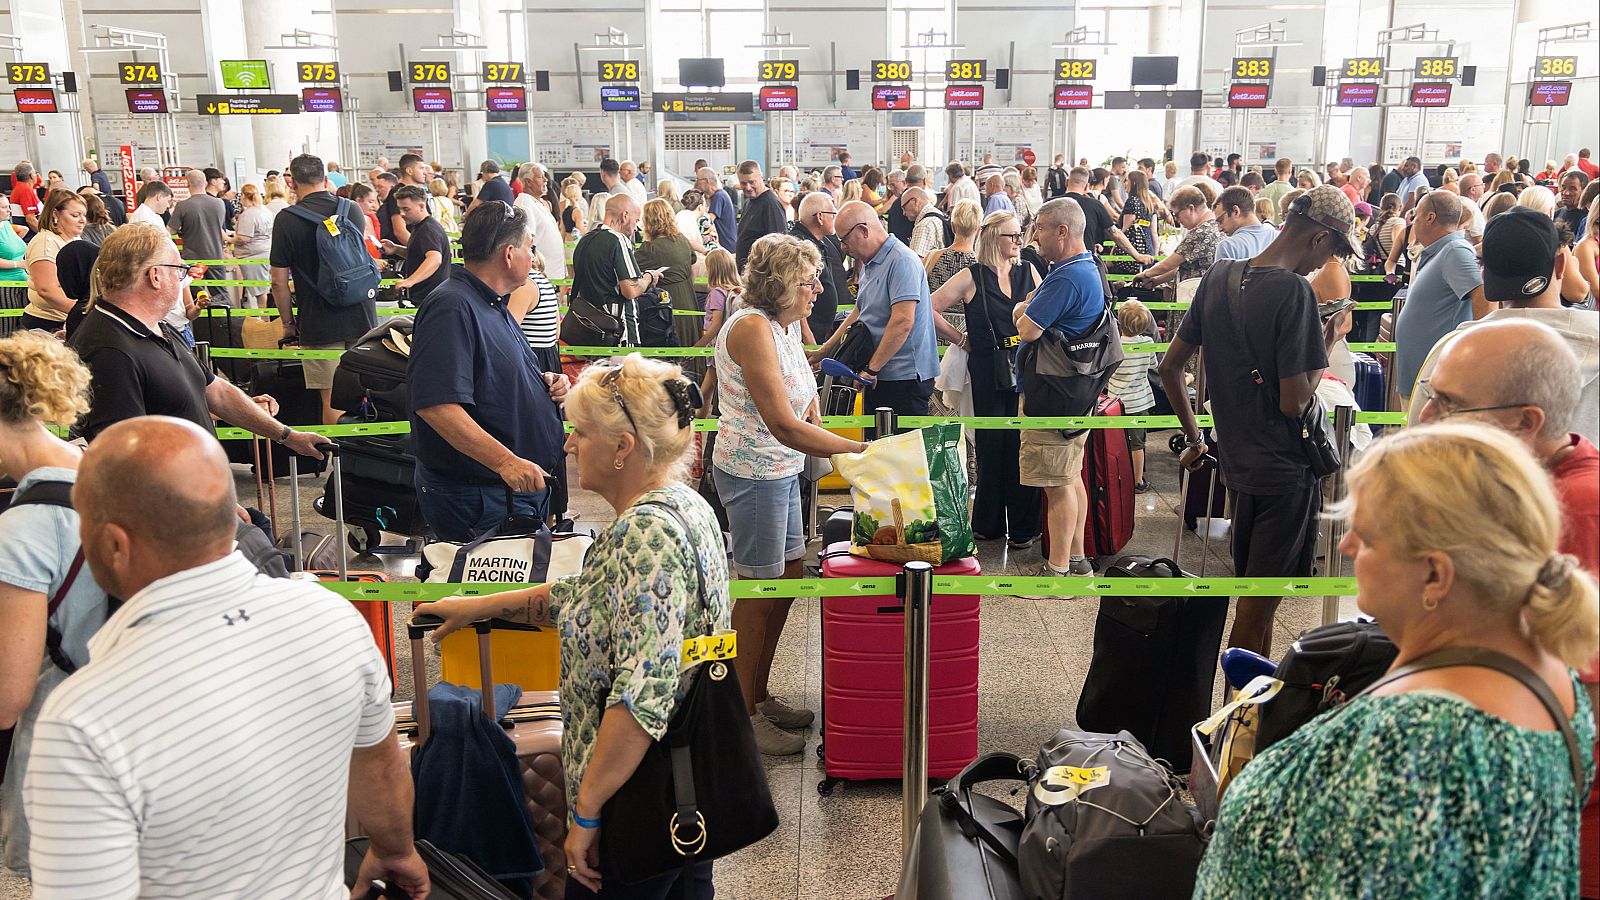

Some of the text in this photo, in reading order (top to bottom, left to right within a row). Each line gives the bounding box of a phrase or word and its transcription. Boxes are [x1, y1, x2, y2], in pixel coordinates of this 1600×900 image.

[11, 65, 46, 82] 373
[124, 65, 158, 82] 374
[302, 64, 336, 81] 375
[413, 64, 447, 81] 376
[487, 64, 520, 81] 377
[603, 63, 637, 80] 378
[762, 63, 795, 79] 379
[875, 63, 910, 79] 380
[950, 62, 982, 79] 381
[1059, 62, 1093, 78] 382
[1236, 60, 1270, 77] 383
[1346, 60, 1380, 76] 384
[1420, 59, 1454, 76] 385
[1540, 58, 1574, 75] 386
[18, 97, 53, 105] Jet2.com
[121, 151, 135, 210] Jet2.com
[469, 557, 528, 570] MARTINI
[467, 569, 525, 583] RACING
